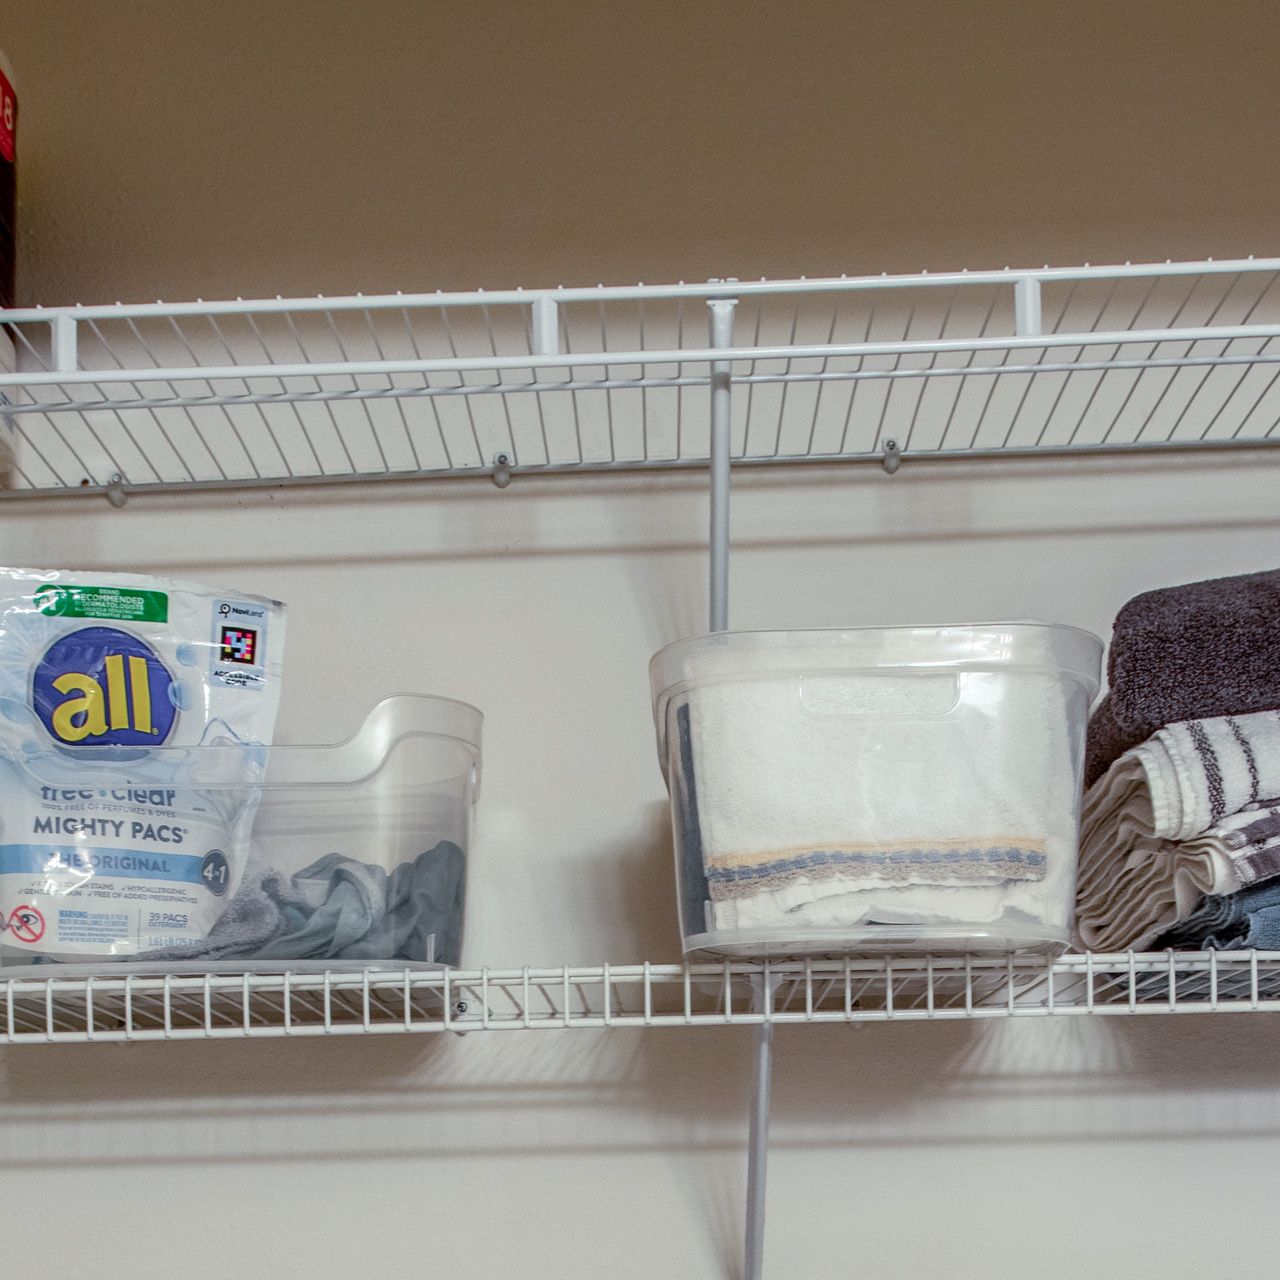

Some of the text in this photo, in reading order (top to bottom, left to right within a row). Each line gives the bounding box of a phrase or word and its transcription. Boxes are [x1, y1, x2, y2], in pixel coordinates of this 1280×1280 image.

[73, 593, 145, 605] ECOMMENDED
[82, 600, 145, 611] DERMATOLOGISTS
[52, 654, 152, 742] all
[41, 803, 62, 811] 100%
[65, 803, 85, 811] FREE
[87, 803, 99, 811] OF
[102, 804, 146, 815] PERFUMES
[156, 810, 176, 818] DYES
[33, 816, 183, 844] MIGHTY PACS
[91, 854, 170, 873] ORIGINAL
[90, 882, 114, 891] STAINS
[127, 885, 187, 896] HYPOALLERGENIC
[94, 890, 110, 899] FREE
[123, 892, 148, 900] ADDED
[149, 912, 188, 923] 39 PACS
[148, 921, 187, 929] DETERGENT
